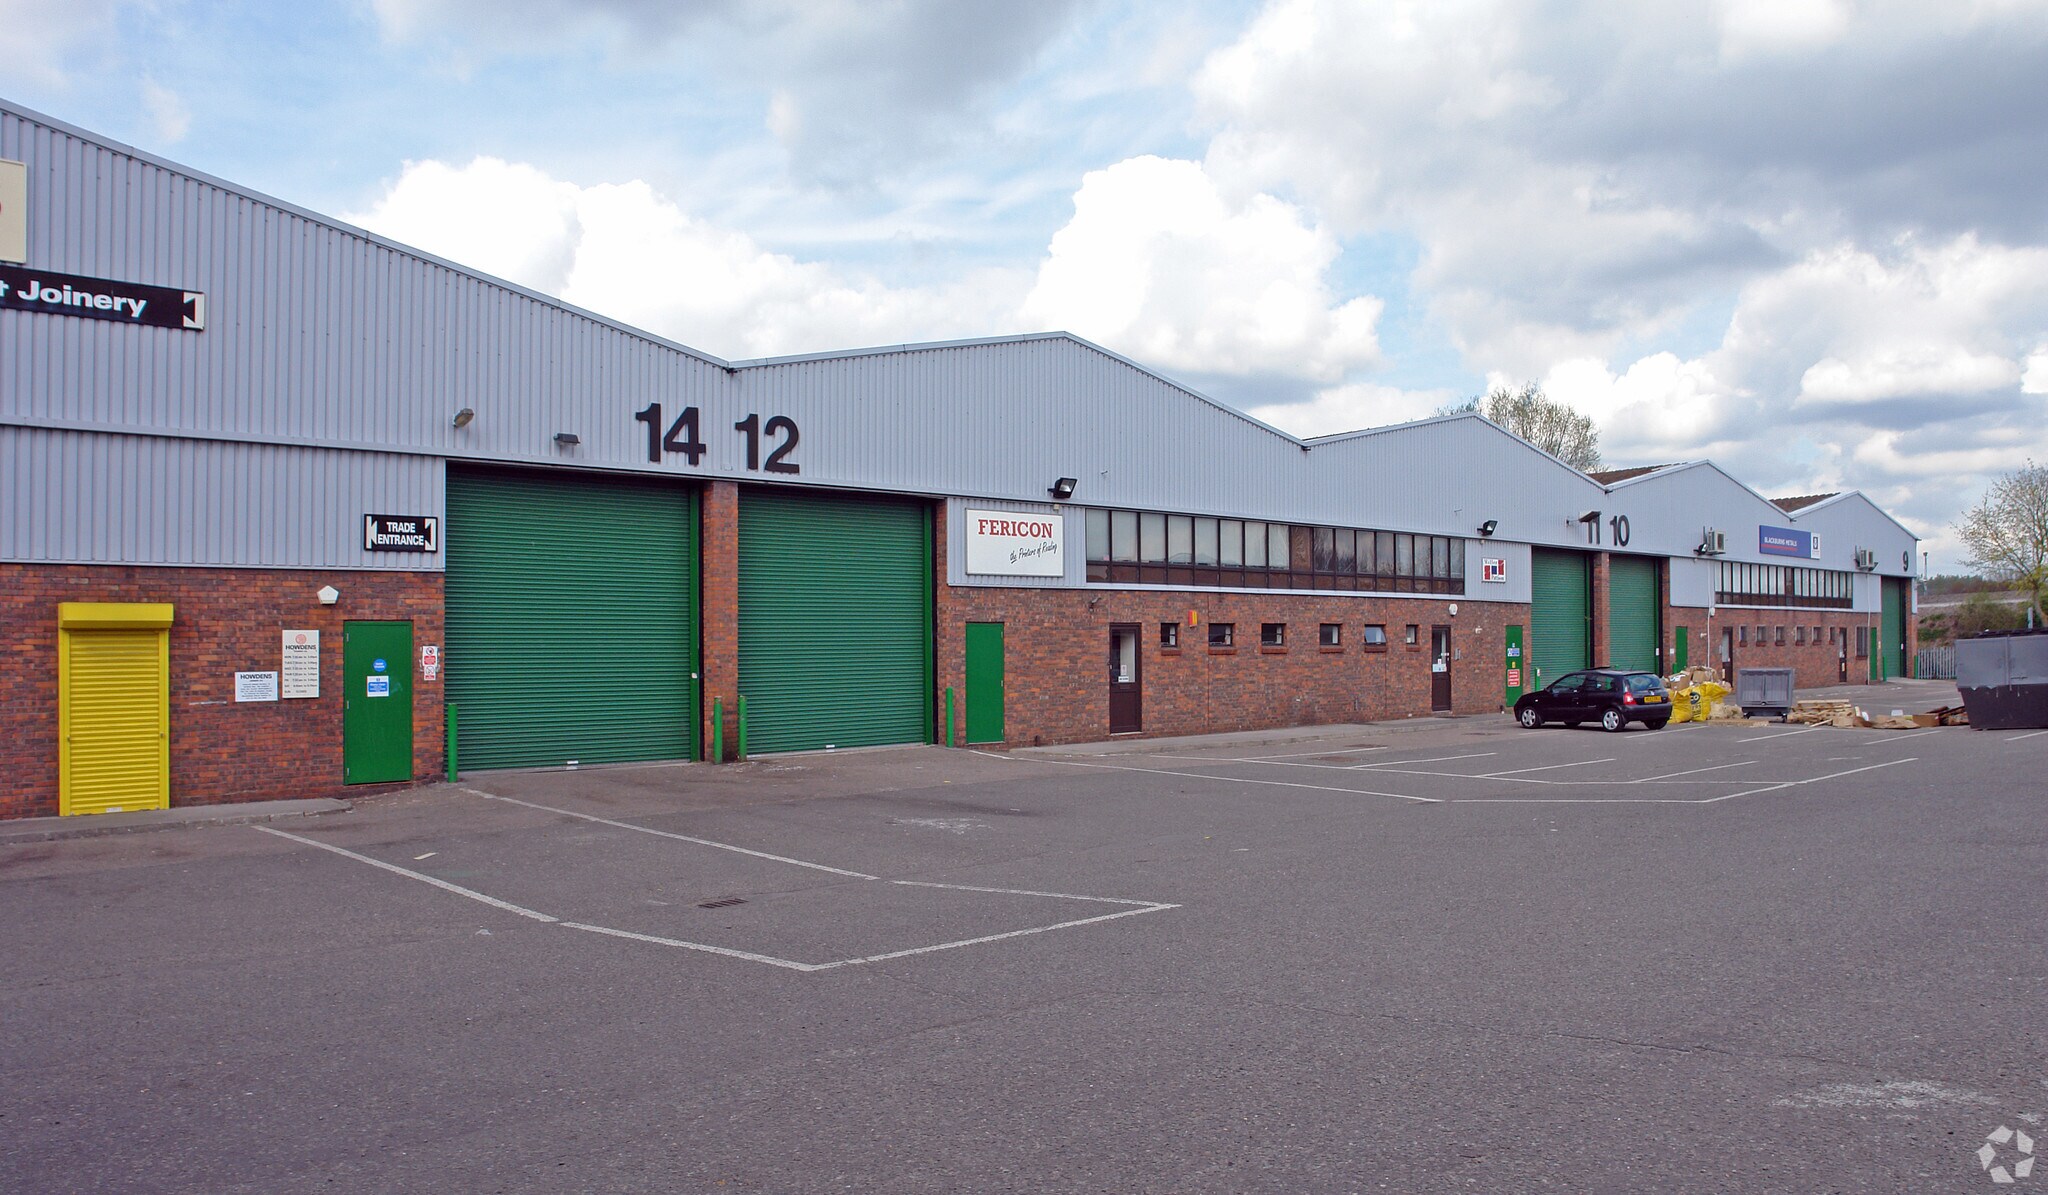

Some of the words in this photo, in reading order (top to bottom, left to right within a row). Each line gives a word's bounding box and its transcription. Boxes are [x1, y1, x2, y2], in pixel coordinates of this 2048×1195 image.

[17, 280, 148, 318] Joinery
[635, 402, 707, 466] 14
[734, 413, 800, 474] 12
[377, 534, 425, 546] ENTRANCE
[386, 521, 416, 533] TRADE
[977, 519, 1053, 539] FERICON
[1609, 514, 1630, 547] 10
[1902, 550, 1909, 572] 9
